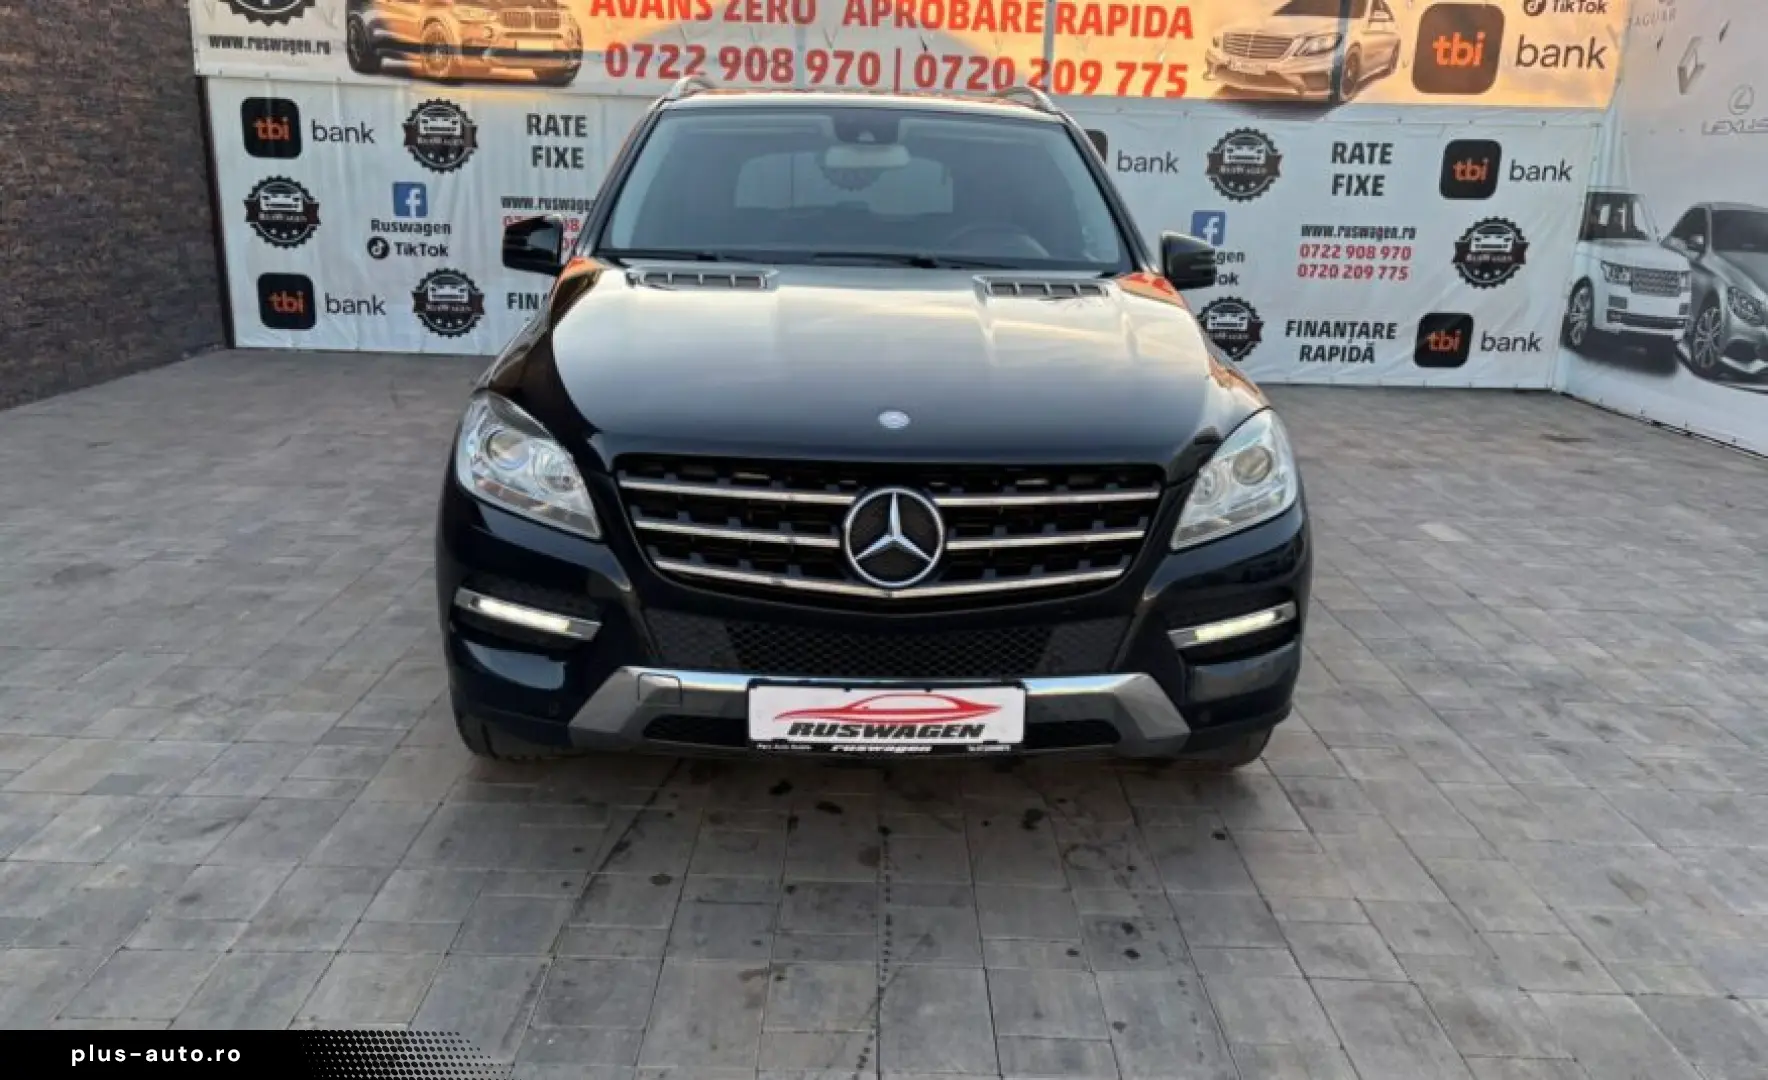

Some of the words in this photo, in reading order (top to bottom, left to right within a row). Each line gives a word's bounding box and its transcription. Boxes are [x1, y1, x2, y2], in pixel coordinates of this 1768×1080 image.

[1552, 0, 1607, 14] TikTok
[590, 0, 713, 20] AVANS
[723, 0, 816, 26] ZERO
[842, 0, 1043, 33] APROBARE
[1055, 3, 1193, 39] RAPIDA
[1432, 31, 1486, 67] tbi
[1515, 34, 1607, 69] bank
[604, 41, 706, 80] 0722
[718, 45, 795, 83] 908
[805, 48, 881, 86] 970
[914, 54, 1015, 91] 0720
[1027, 57, 1102, 96] 209
[1115, 61, 1188, 98] 775
[253, 116, 290, 141] tbi
[311, 118, 376, 145] bank
[526, 113, 588, 138] RATE
[531, 145, 585, 169] FIXE
[1117, 149, 1179, 173] bank
[1331, 142, 1393, 165] RATE
[1453, 157, 1489, 181] tbi
[1508, 159, 1573, 182] bank
[1331, 173, 1385, 197] FIXE
[370, 219, 452, 236] Ruswagen
[394, 239, 449, 258] TikTok
[1299, 243, 1341, 259] 0722
[1345, 244, 1379, 260] 908
[1383, 245, 1412, 261] 970
[1297, 263, 1338, 279] 0720
[1342, 264, 1373, 280] 209
[1377, 266, 1408, 281] 775
[269, 291, 304, 314] tbi
[324, 293, 386, 316] bank
[1299, 342, 1376, 364] RAPIDĂ
[1426, 330, 1461, 351] tbi
[1480, 331, 1541, 352] bank
[787, 721, 985, 739] RUSWAGEN
